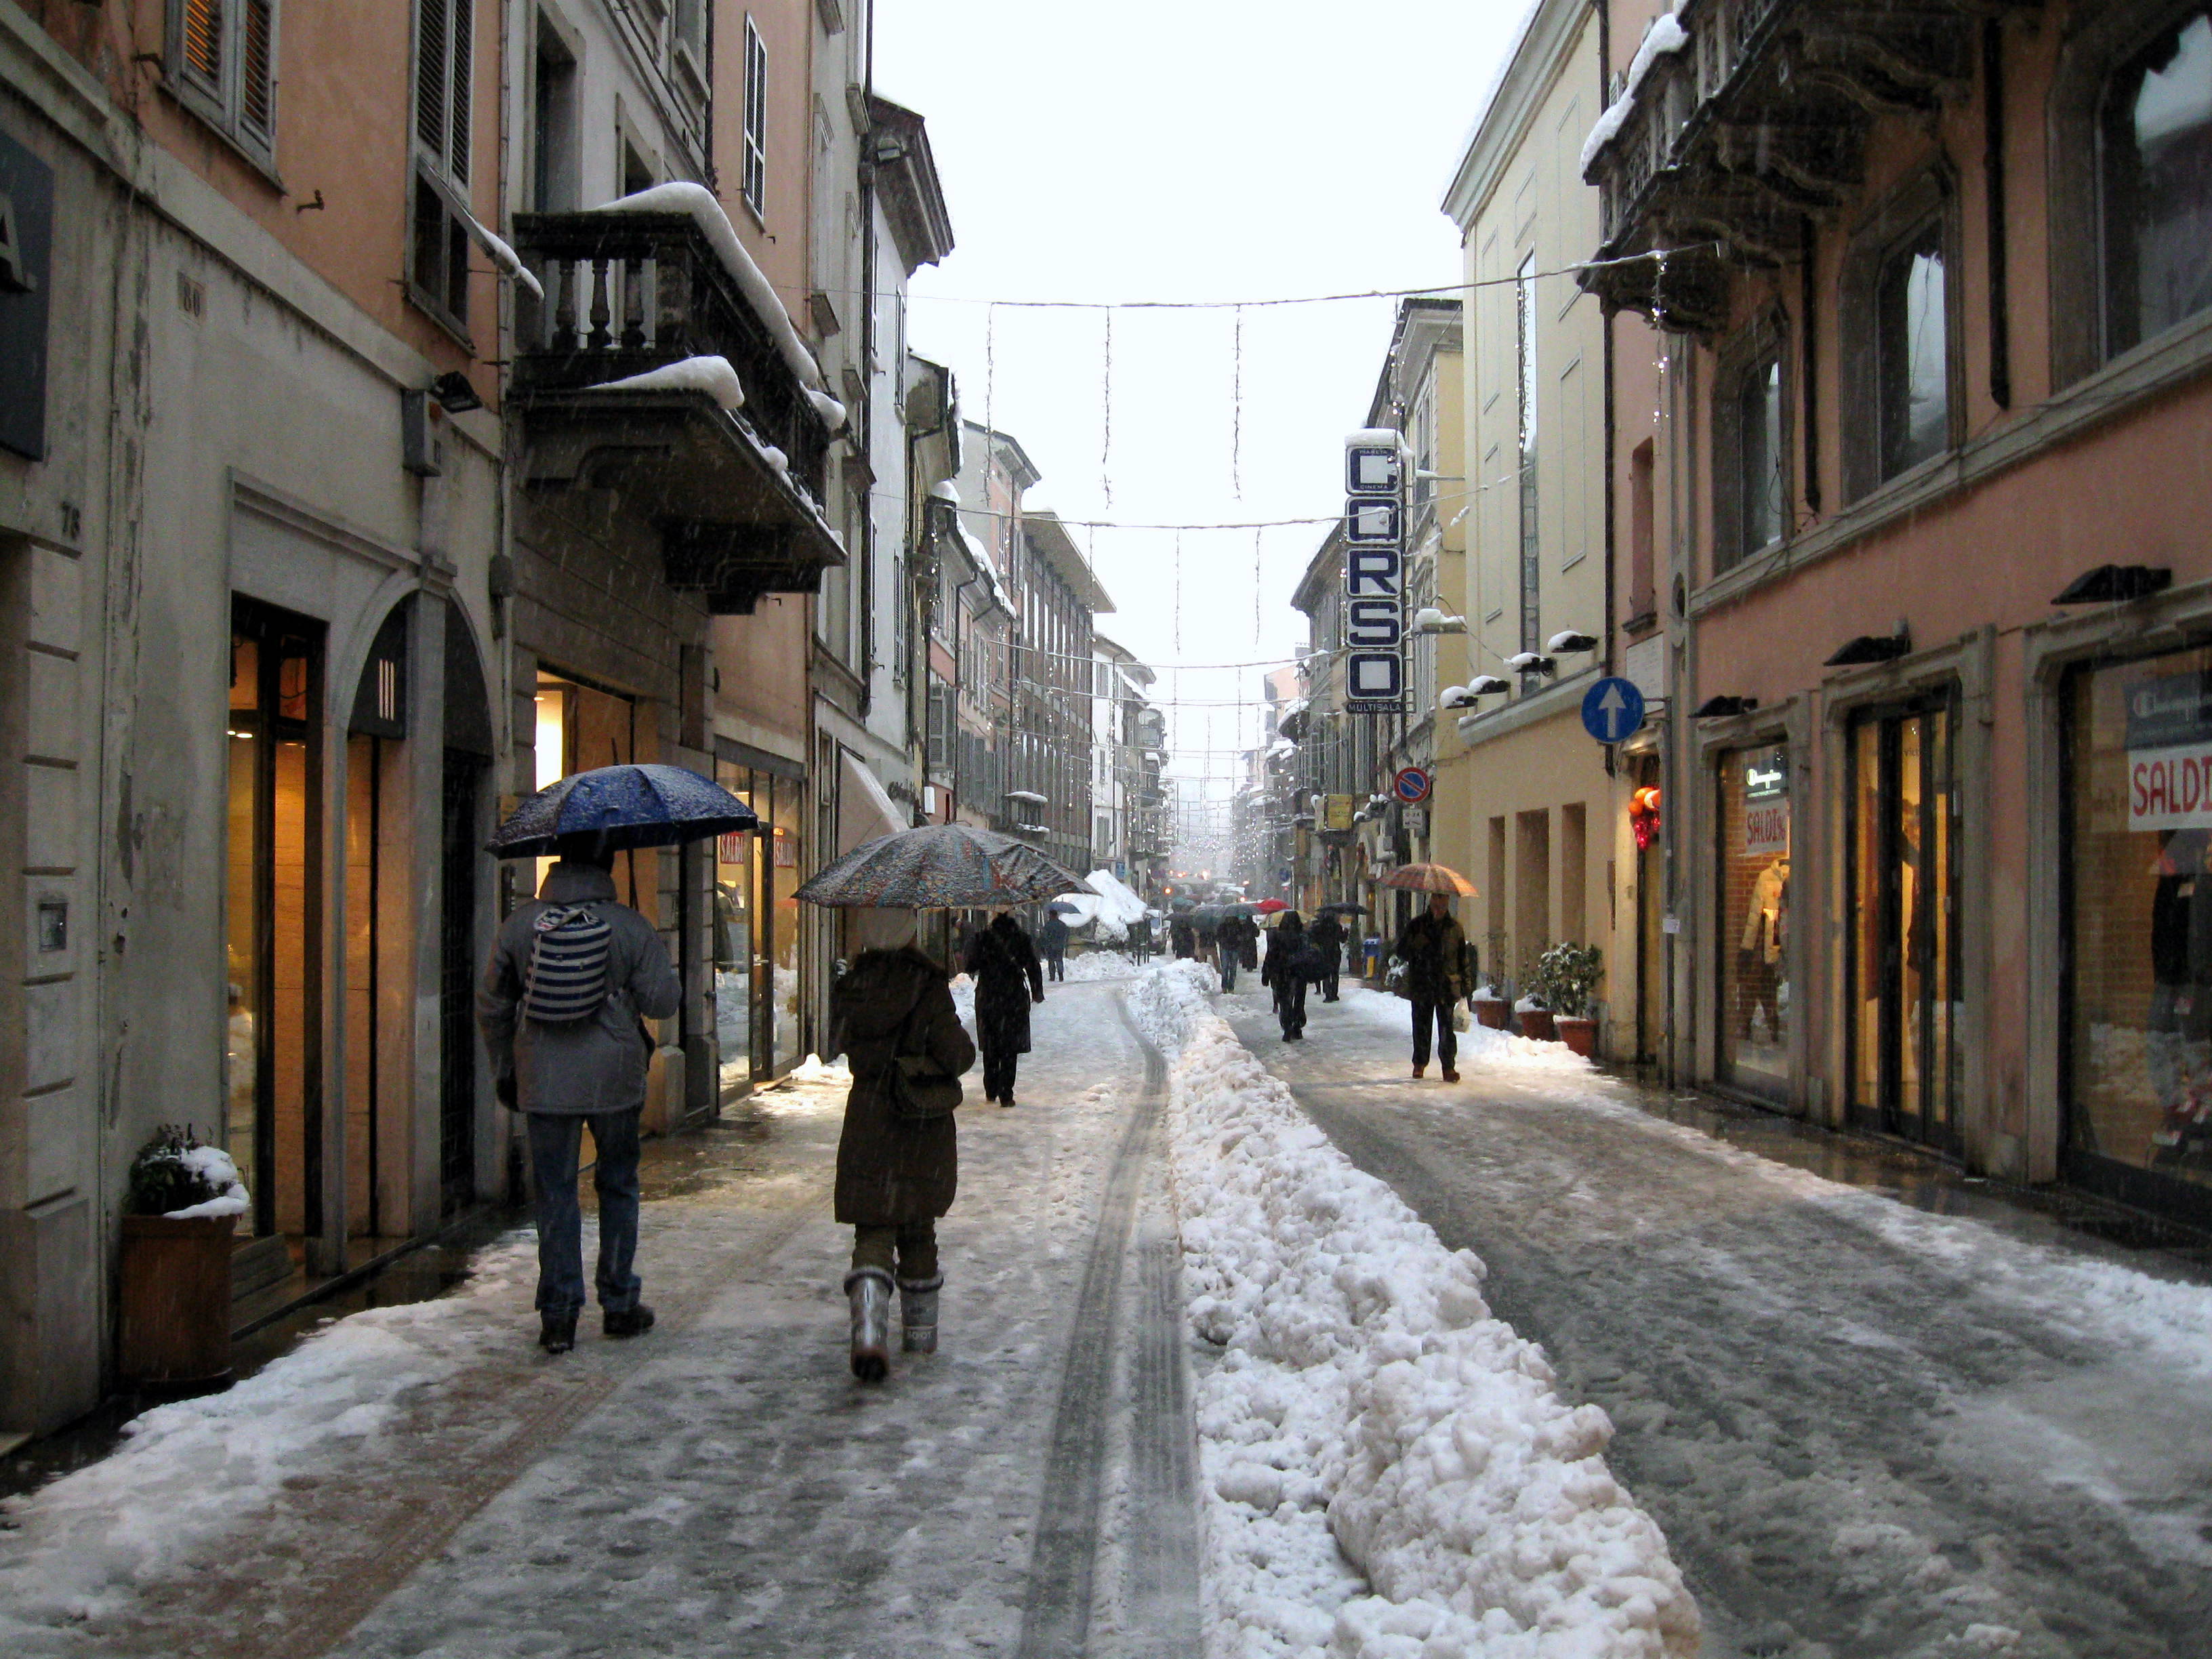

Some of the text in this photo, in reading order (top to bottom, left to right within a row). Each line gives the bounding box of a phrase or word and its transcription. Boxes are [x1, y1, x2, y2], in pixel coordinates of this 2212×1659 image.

[1350, 448, 1400, 697] CORSO
[1348, 703, 1401, 712] MULTISALA
[2133, 754, 2212, 817] SALDI
[721, 834, 743, 863] SALDI
[776, 840, 794, 866] SALDI
